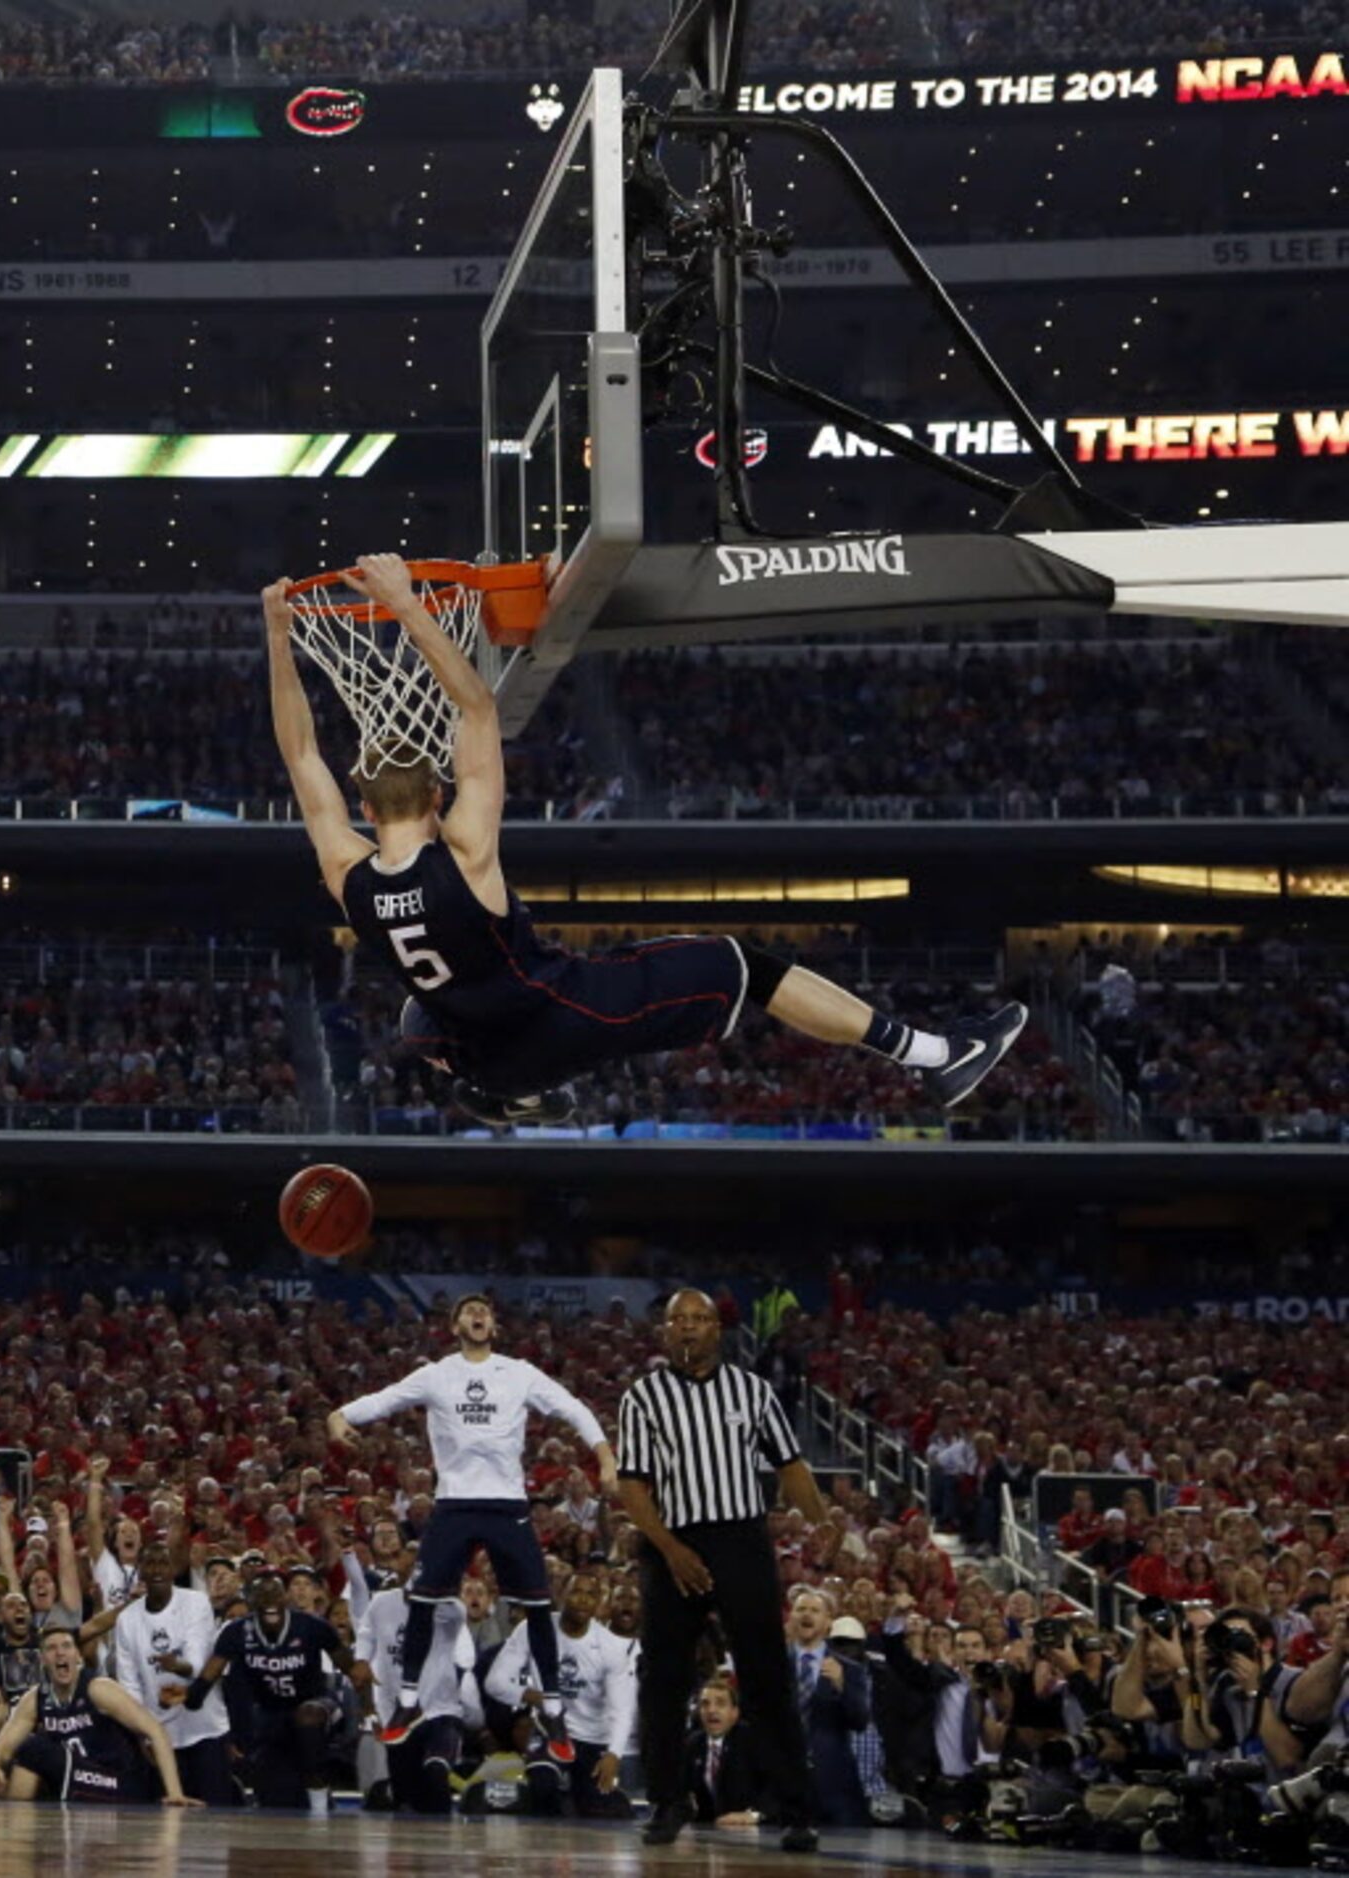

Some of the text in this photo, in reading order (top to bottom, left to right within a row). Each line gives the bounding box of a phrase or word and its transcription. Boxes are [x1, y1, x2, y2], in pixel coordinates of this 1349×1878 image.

[737, 54, 1349, 113] ELCOME TO THE 2014 NCAA
[1213, 242, 1250, 264] 55
[1270, 237, 1324, 263] LEE
[453, 264, 480, 286] 12
[1066, 412, 1280, 463] THERE
[715, 534, 908, 586] SPALDING
[387, 923, 454, 992] 5
[244, 1652, 306, 1673] UCONN
[73, 1768, 118, 1790] UCONN
